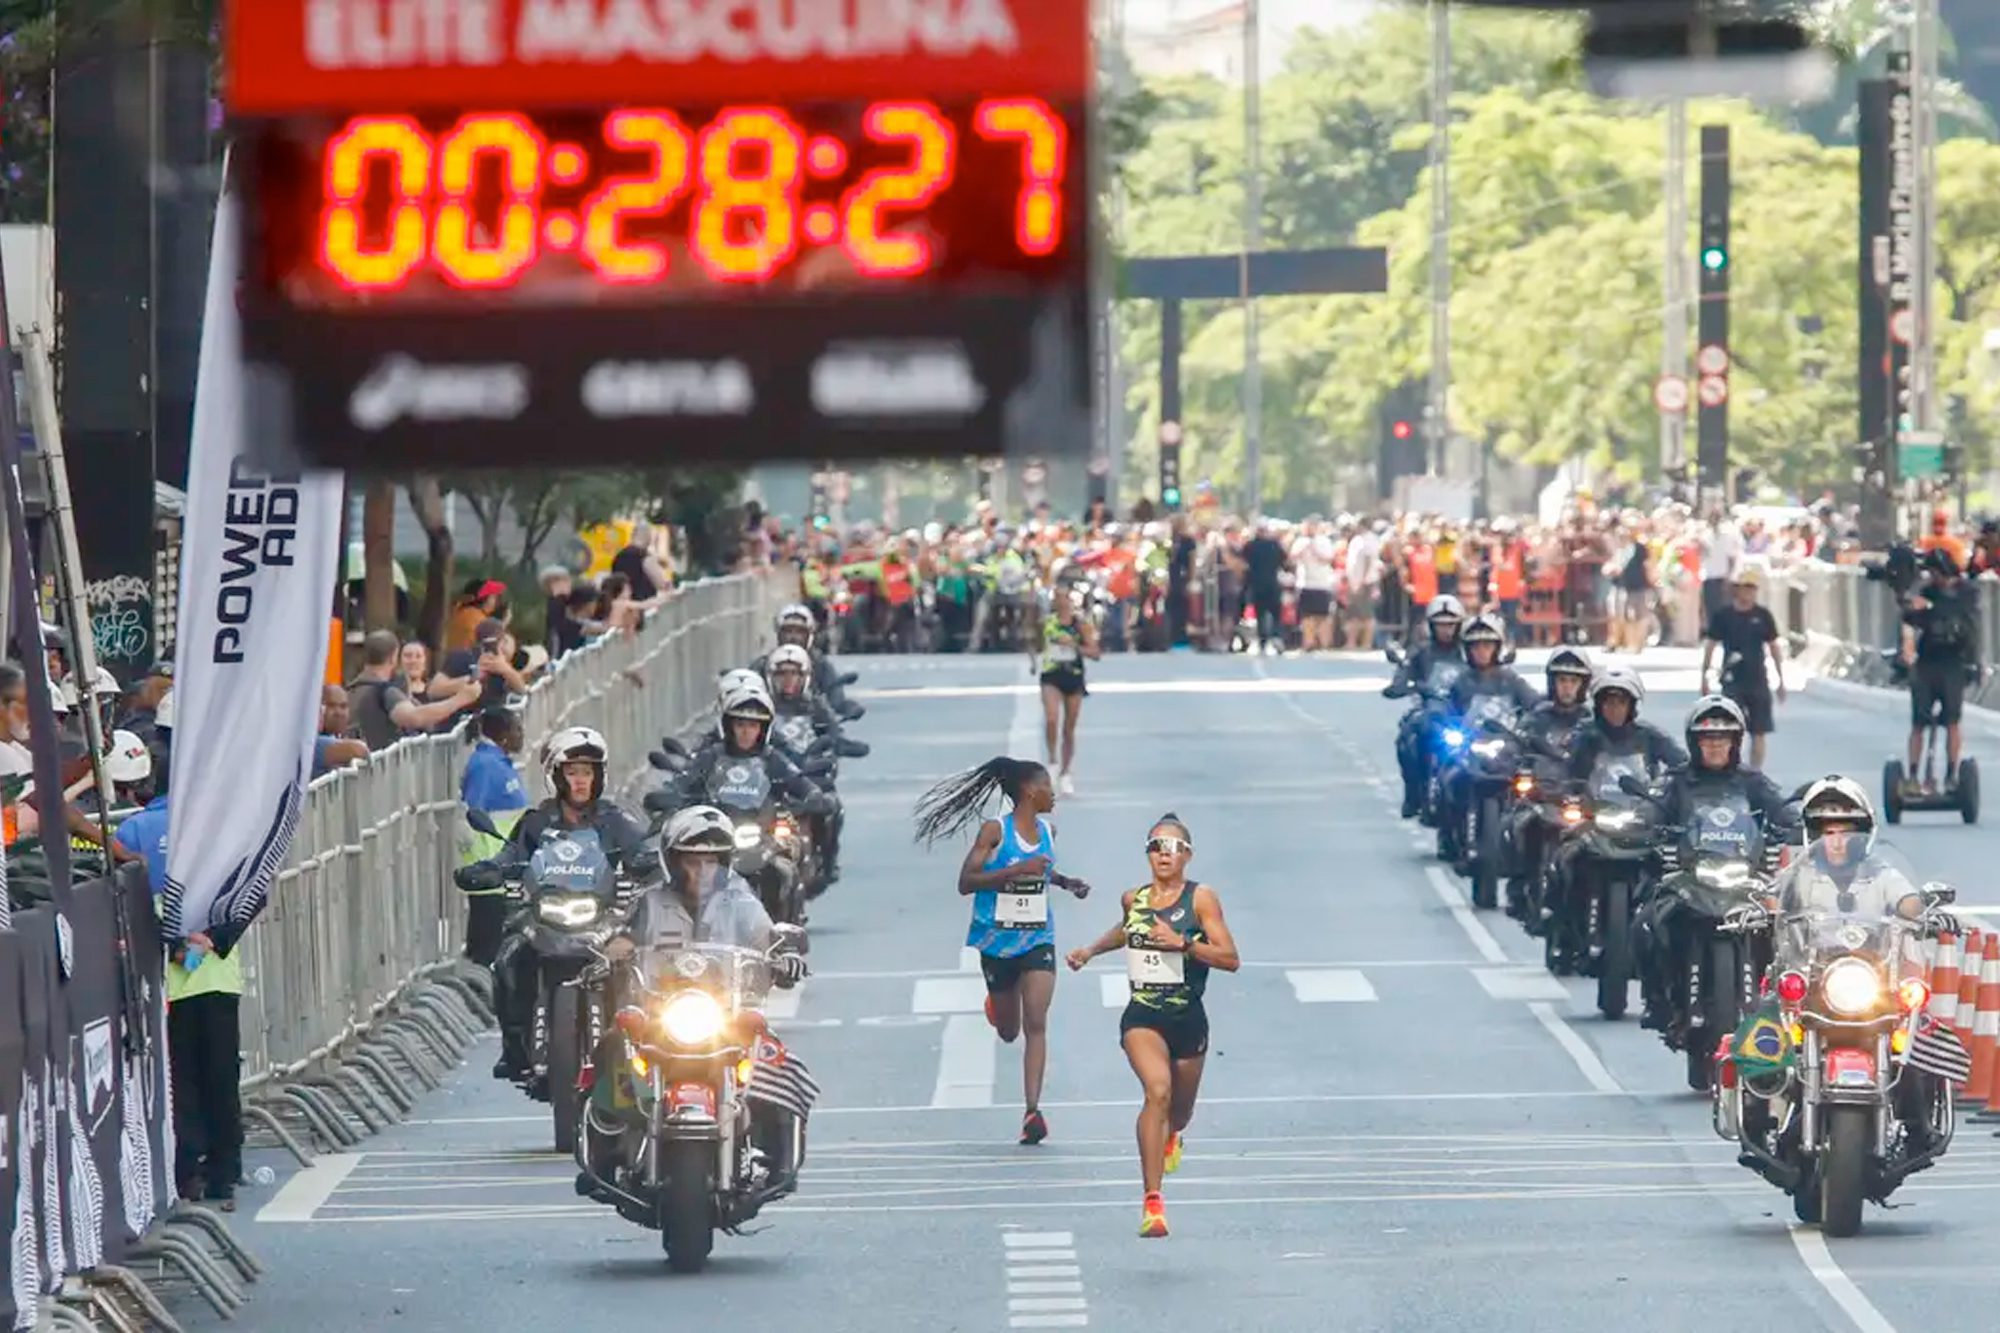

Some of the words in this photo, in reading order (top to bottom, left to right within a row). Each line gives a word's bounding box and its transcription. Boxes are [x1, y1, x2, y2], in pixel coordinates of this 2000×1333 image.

[316, 98, 1068, 291] 00:28:27
[261, 474, 301, 566] AD
[1015, 898, 1029, 908] 41
[1143, 954, 1160, 966] 45
